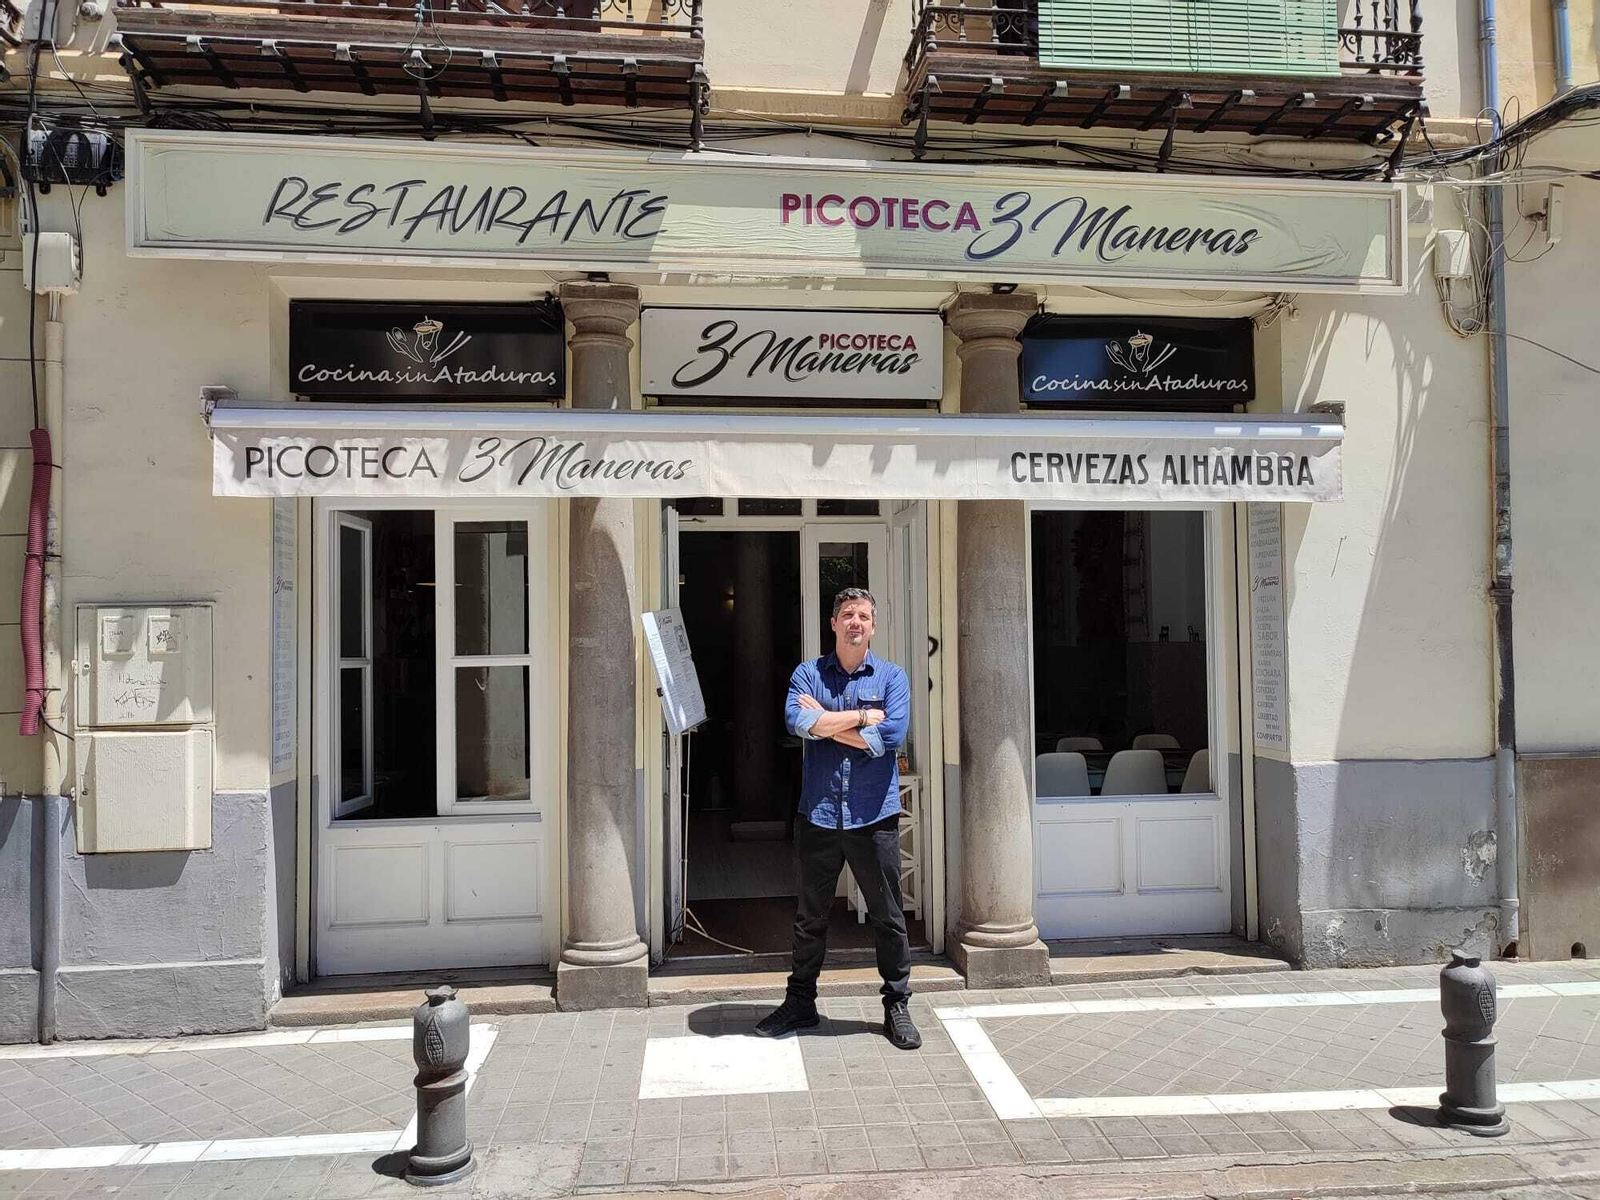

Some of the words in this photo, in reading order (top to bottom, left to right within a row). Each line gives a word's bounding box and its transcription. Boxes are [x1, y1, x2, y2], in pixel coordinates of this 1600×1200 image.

[262, 176, 669, 245] RESTAURANTE
[780, 193, 981, 233] PICOTECA
[964, 191, 1032, 261] 3
[1030, 196, 1263, 263] Maneras
[672, 320, 738, 389] 3
[730, 329, 923, 383] Maneras
[818, 333, 917, 352] PICOTECA
[245, 446, 438, 479] PICOTECA
[458, 437, 501, 482] 3
[500, 436, 696, 490] Maneras
[1011, 451, 1150, 485] CERVEZAS
[1162, 453, 1315, 488] ALHAMBRA
